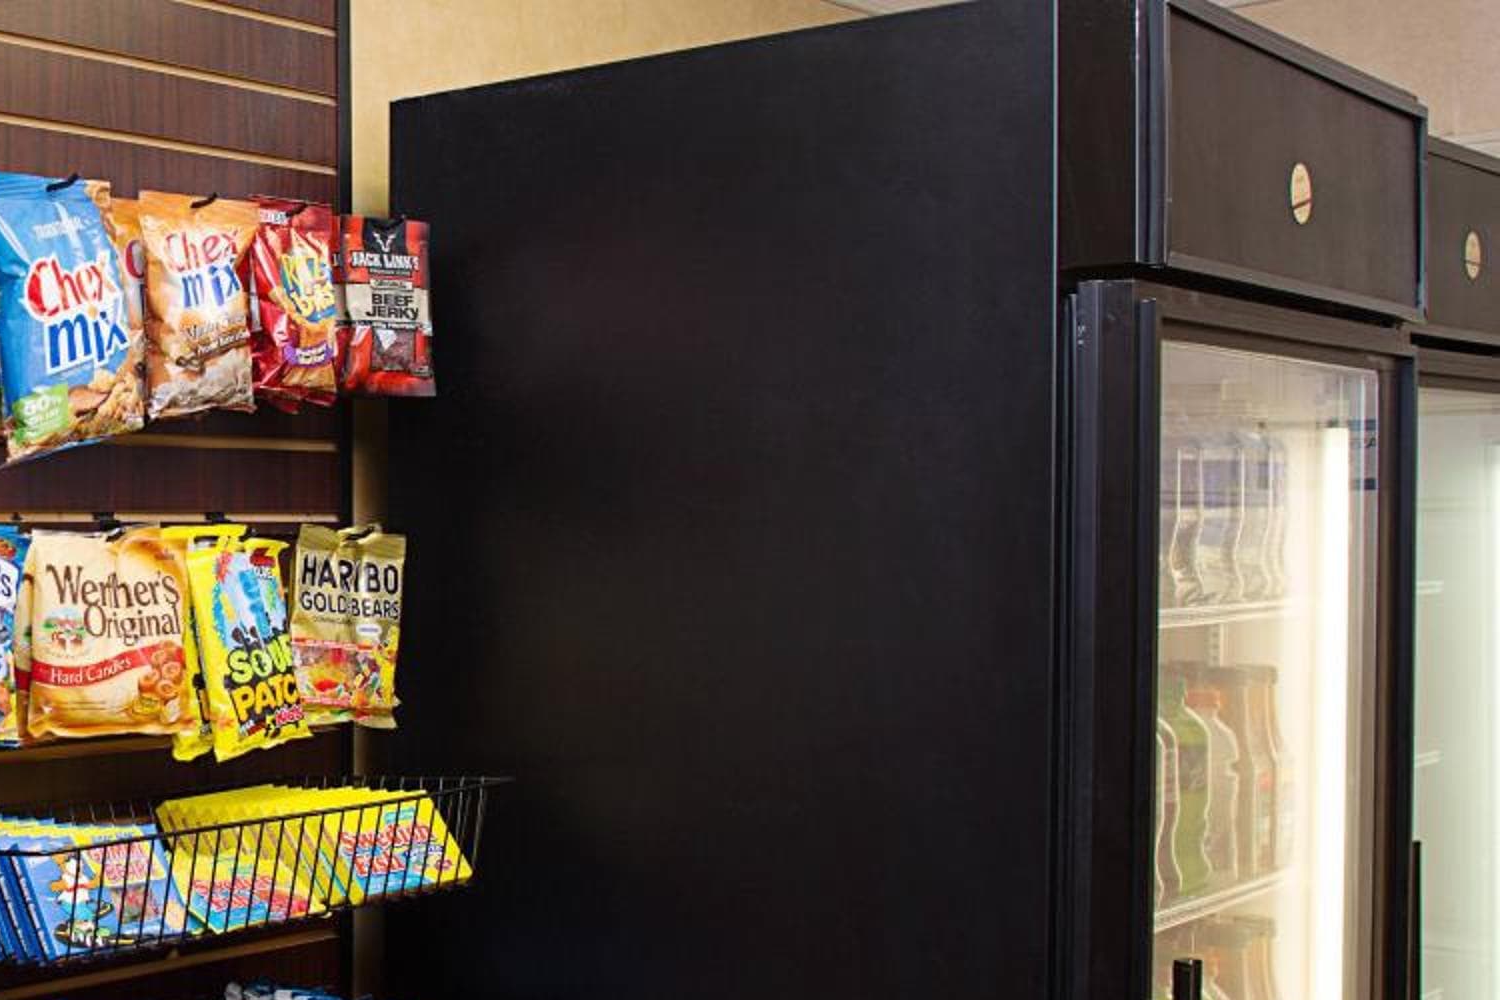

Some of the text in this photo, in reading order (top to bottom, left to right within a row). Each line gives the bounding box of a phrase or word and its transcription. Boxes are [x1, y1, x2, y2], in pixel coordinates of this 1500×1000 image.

[165, 229, 239, 273] Chex
[181, 260, 240, 308] mix
[371, 293, 414, 306] BEEF
[365, 306, 419, 320] JERKY
[50, 306, 128, 369] mix
[45, 563, 180, 609] Werther's
[301, 554, 399, 595] HARIBO
[83, 602, 181, 647] Original
[50, 668, 83, 685] Hard
[231, 673, 300, 722] PATC
